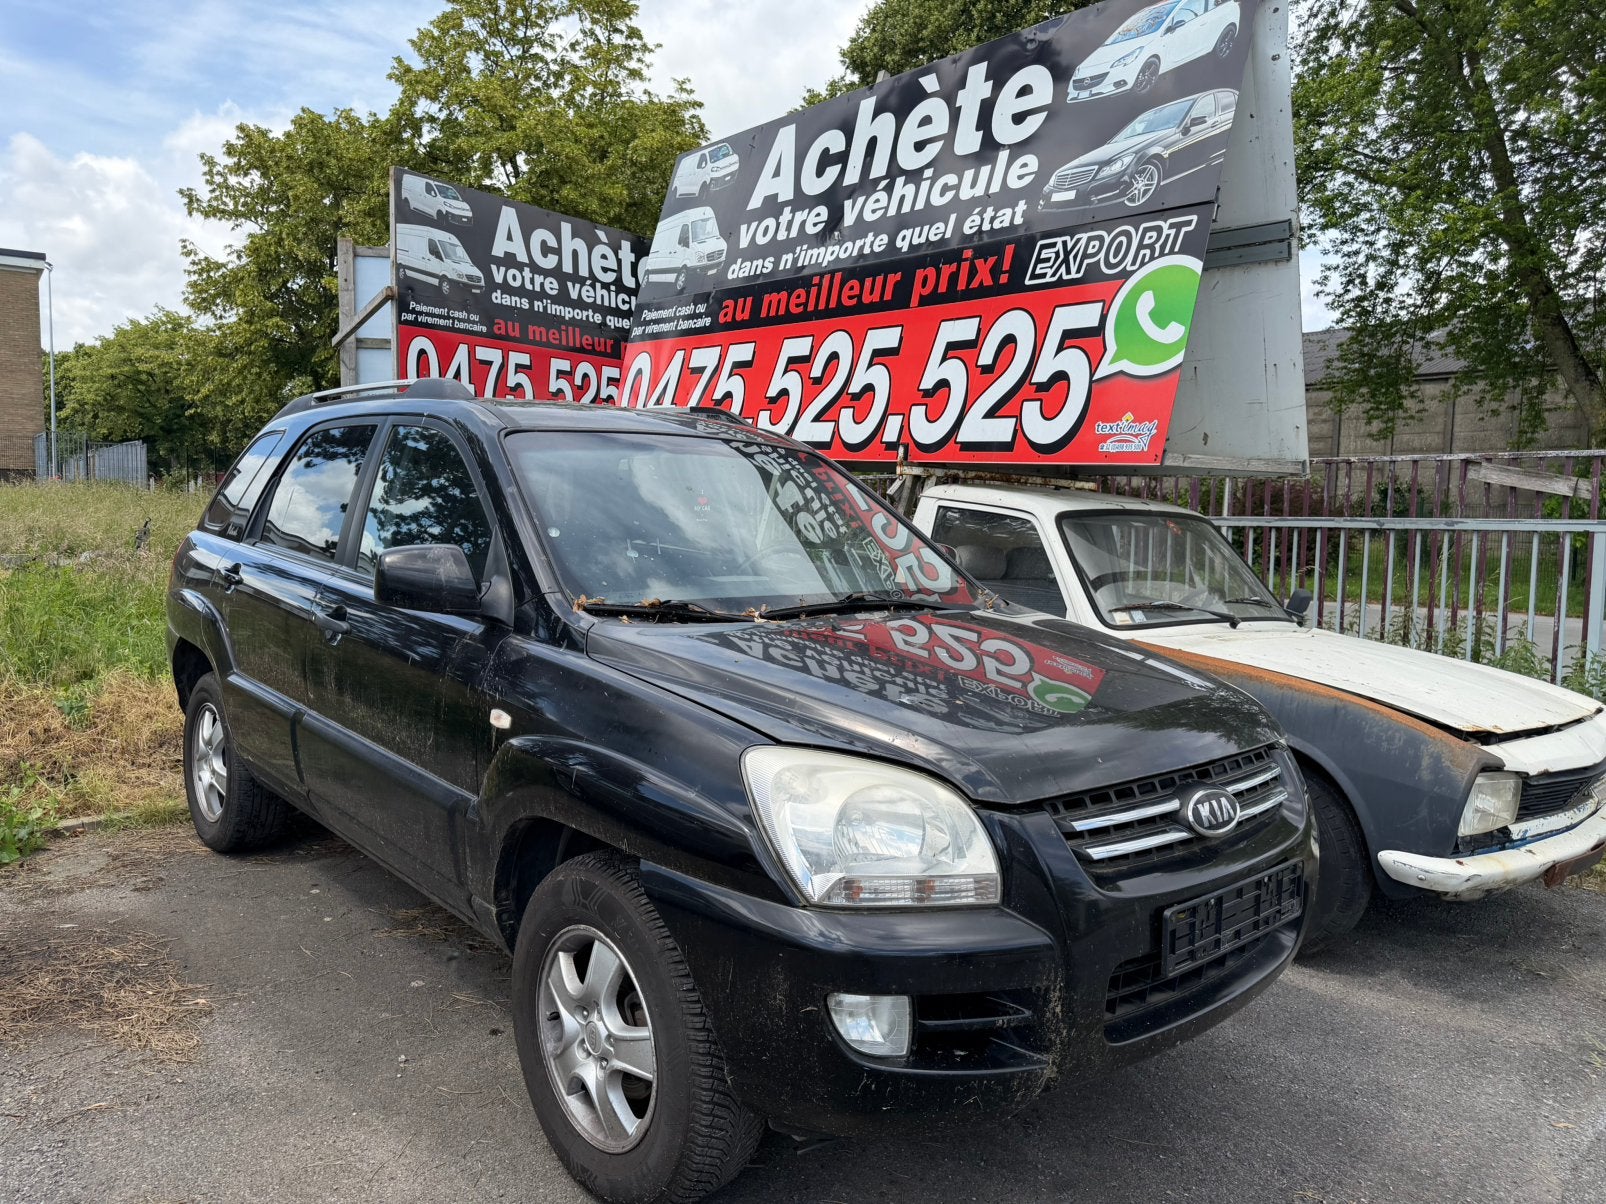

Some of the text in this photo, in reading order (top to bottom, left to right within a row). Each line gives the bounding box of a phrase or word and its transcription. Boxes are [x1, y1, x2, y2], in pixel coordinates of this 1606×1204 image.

[746, 61, 1053, 211] Achète
[738, 150, 1040, 249] votre véhicule
[727, 200, 1027, 280] dans n'importe quel état
[1025, 215, 1197, 285] EXPORT
[490, 264, 559, 296] votre
[718, 244, 1015, 324] au meilleur prix!
[401, 312, 487, 333] par virement bancaire
[409, 301, 480, 322] Paiement cash ou
[491, 289, 529, 310] dans
[534, 298, 602, 325] n'importe
[641, 302, 707, 321] Paiement cash ou
[493, 318, 521, 338] au
[528, 322, 615, 353] meilleur
[631, 315, 712, 338] par virement bancaire
[620, 302, 1105, 452] 0475525.525
[1197, 796, 1236, 828] KIA
